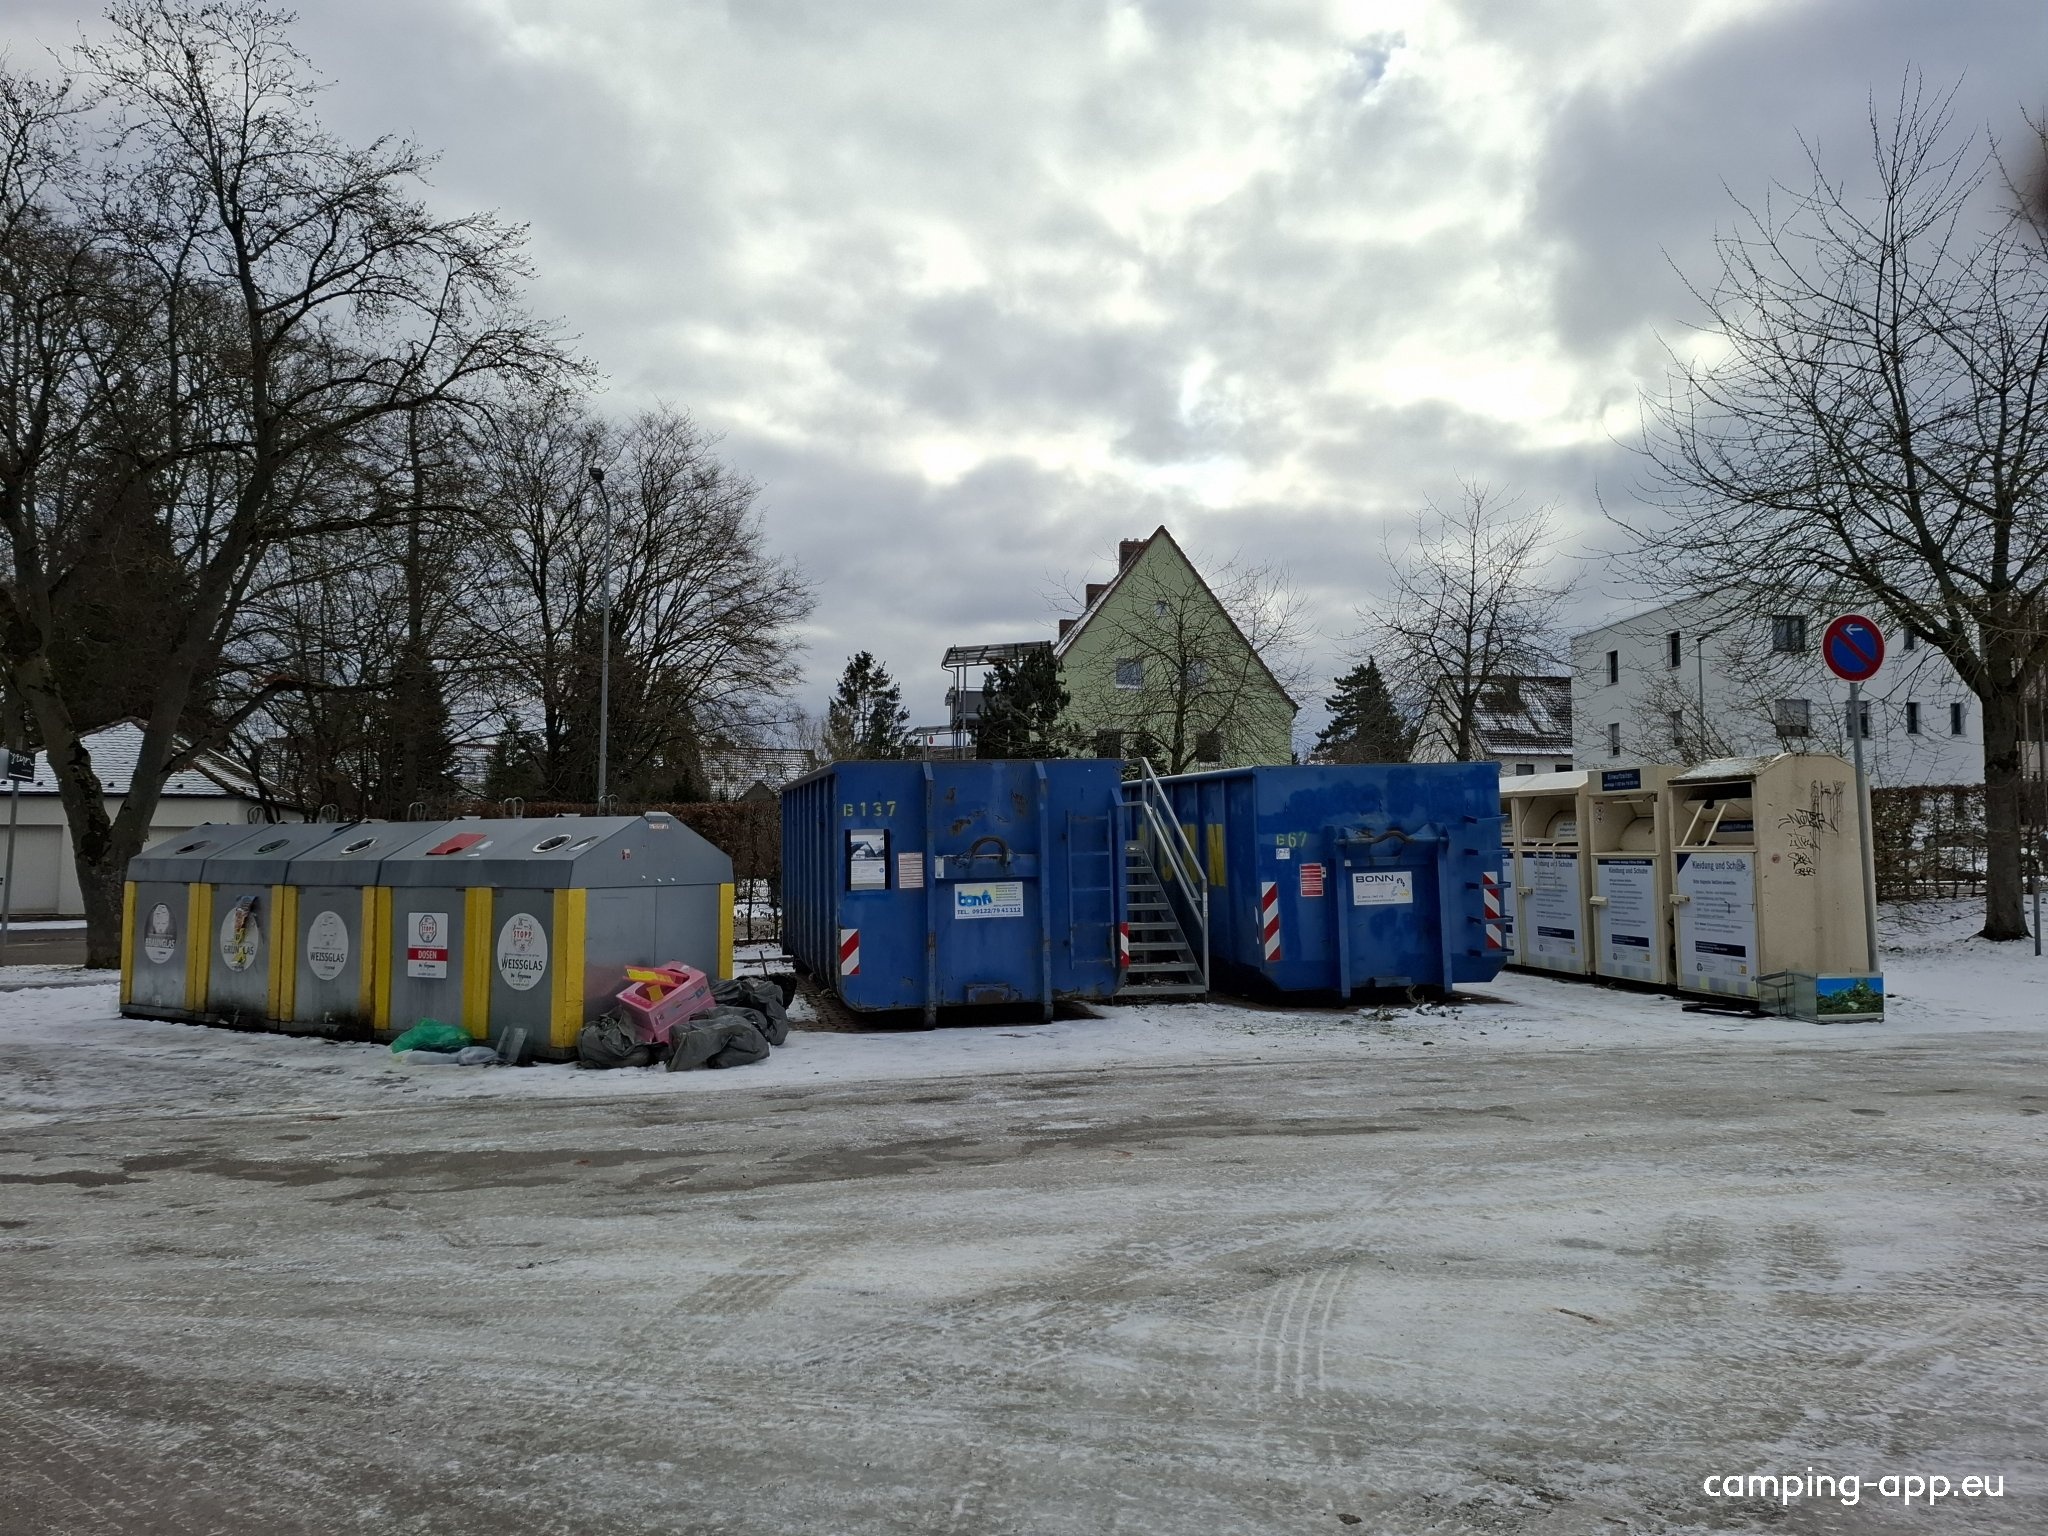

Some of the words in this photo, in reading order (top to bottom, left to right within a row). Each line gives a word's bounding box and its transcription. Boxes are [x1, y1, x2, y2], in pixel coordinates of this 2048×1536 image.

[1355, 874, 1394, 884] BONN
[513, 930, 532, 938] STOPP
[223, 943, 255, 956] GRÜNLAS
[417, 950, 437, 960] DOSEN
[310, 951, 345, 963] WEISSGLAS
[501, 958, 543, 971] WEISSGLAS
